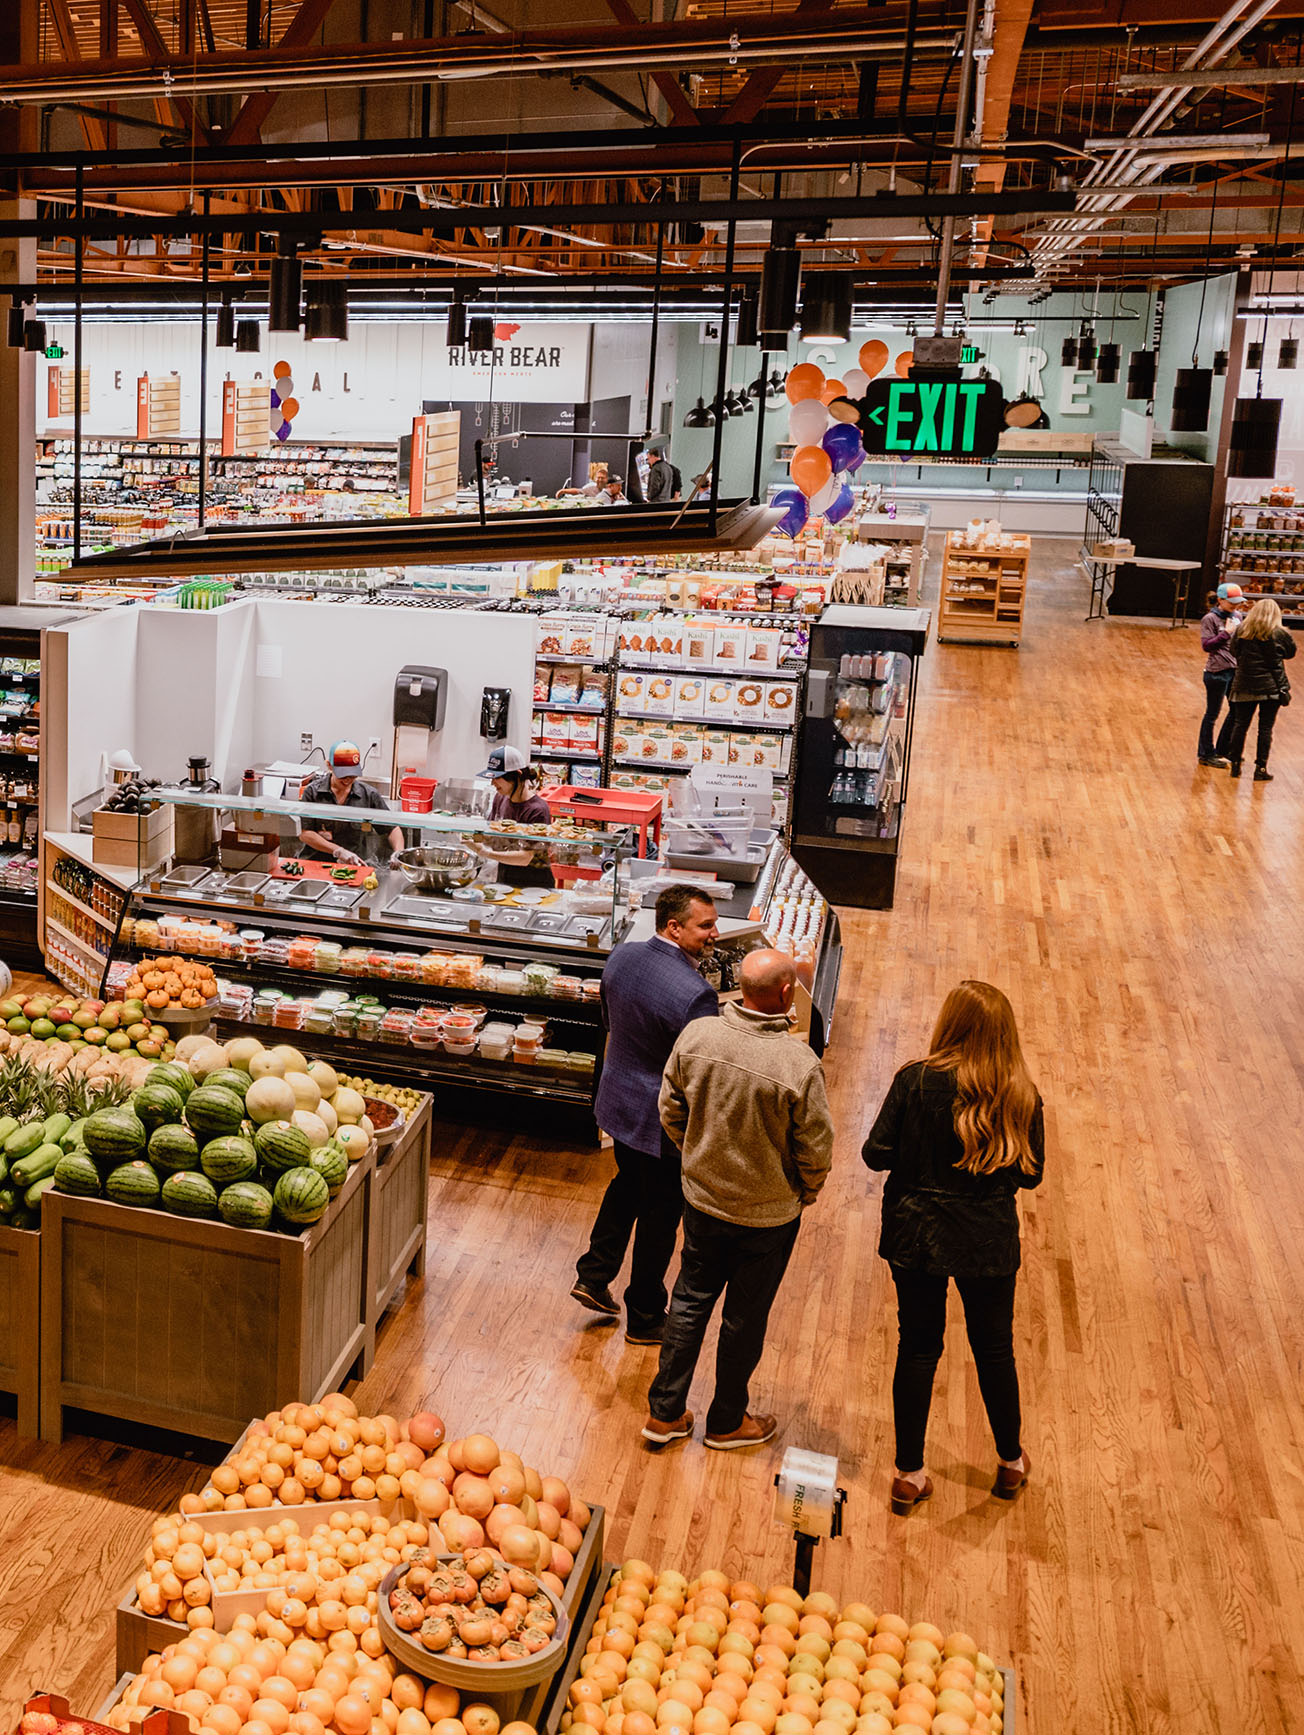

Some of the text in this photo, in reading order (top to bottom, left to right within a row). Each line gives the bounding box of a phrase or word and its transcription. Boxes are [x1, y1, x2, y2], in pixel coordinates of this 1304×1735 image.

[47, 346, 62, 358] EXIT
[448, 347, 561, 367] RIVER BEAR
[960, 347, 977, 363] XIT
[140, 382, 147, 405] 3
[226, 387, 234, 415] 2
[885, 383, 987, 452] EXIT
[417, 425, 424, 460] 1
[626, 626, 646, 635] Kashi
[657, 628, 677, 636] Kashi
[687, 631, 708, 640] Kashi
[719, 632, 740, 640] Kashi
[751, 634, 772, 643] Kashi
[791, 1483, 806, 1519] FRESH
